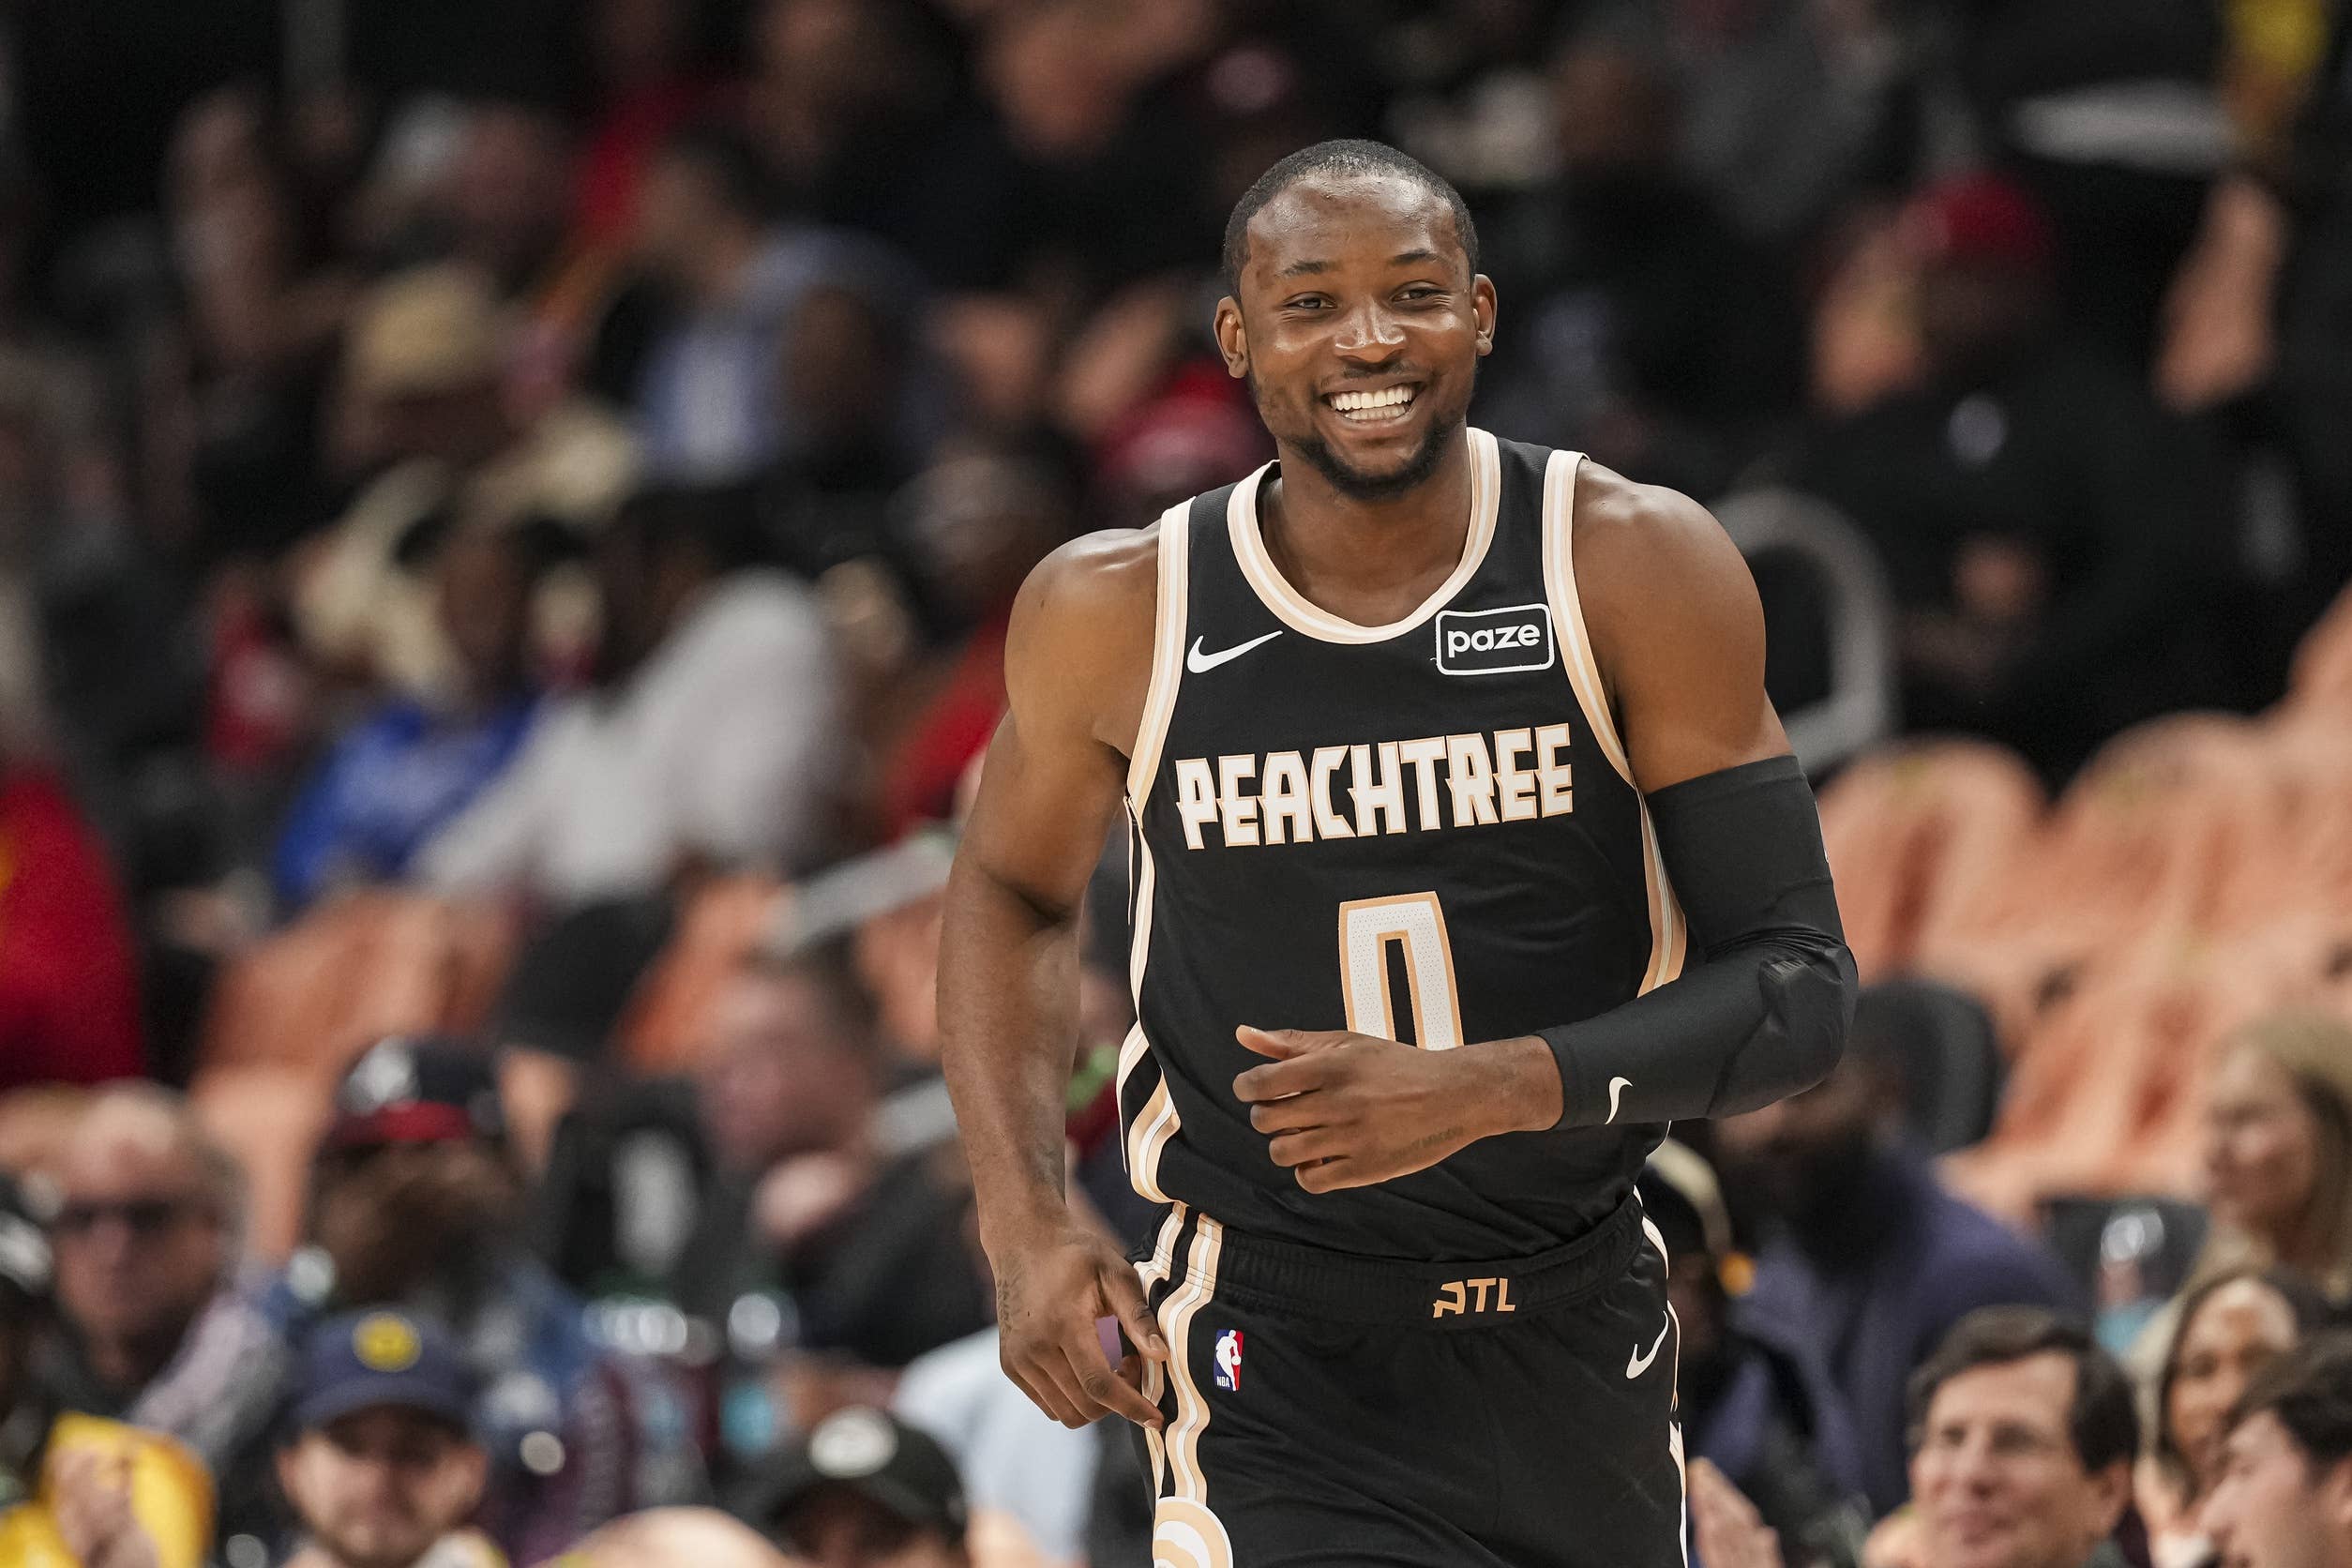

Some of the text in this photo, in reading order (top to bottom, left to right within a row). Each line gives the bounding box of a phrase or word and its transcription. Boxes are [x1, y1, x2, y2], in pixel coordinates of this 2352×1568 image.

[1448, 624, 1540, 658] paze
[1175, 723, 1573, 850] PEACHTREE
[1433, 1277, 1515, 1319] ATL
[1216, 1376, 1229, 1388] NBA
